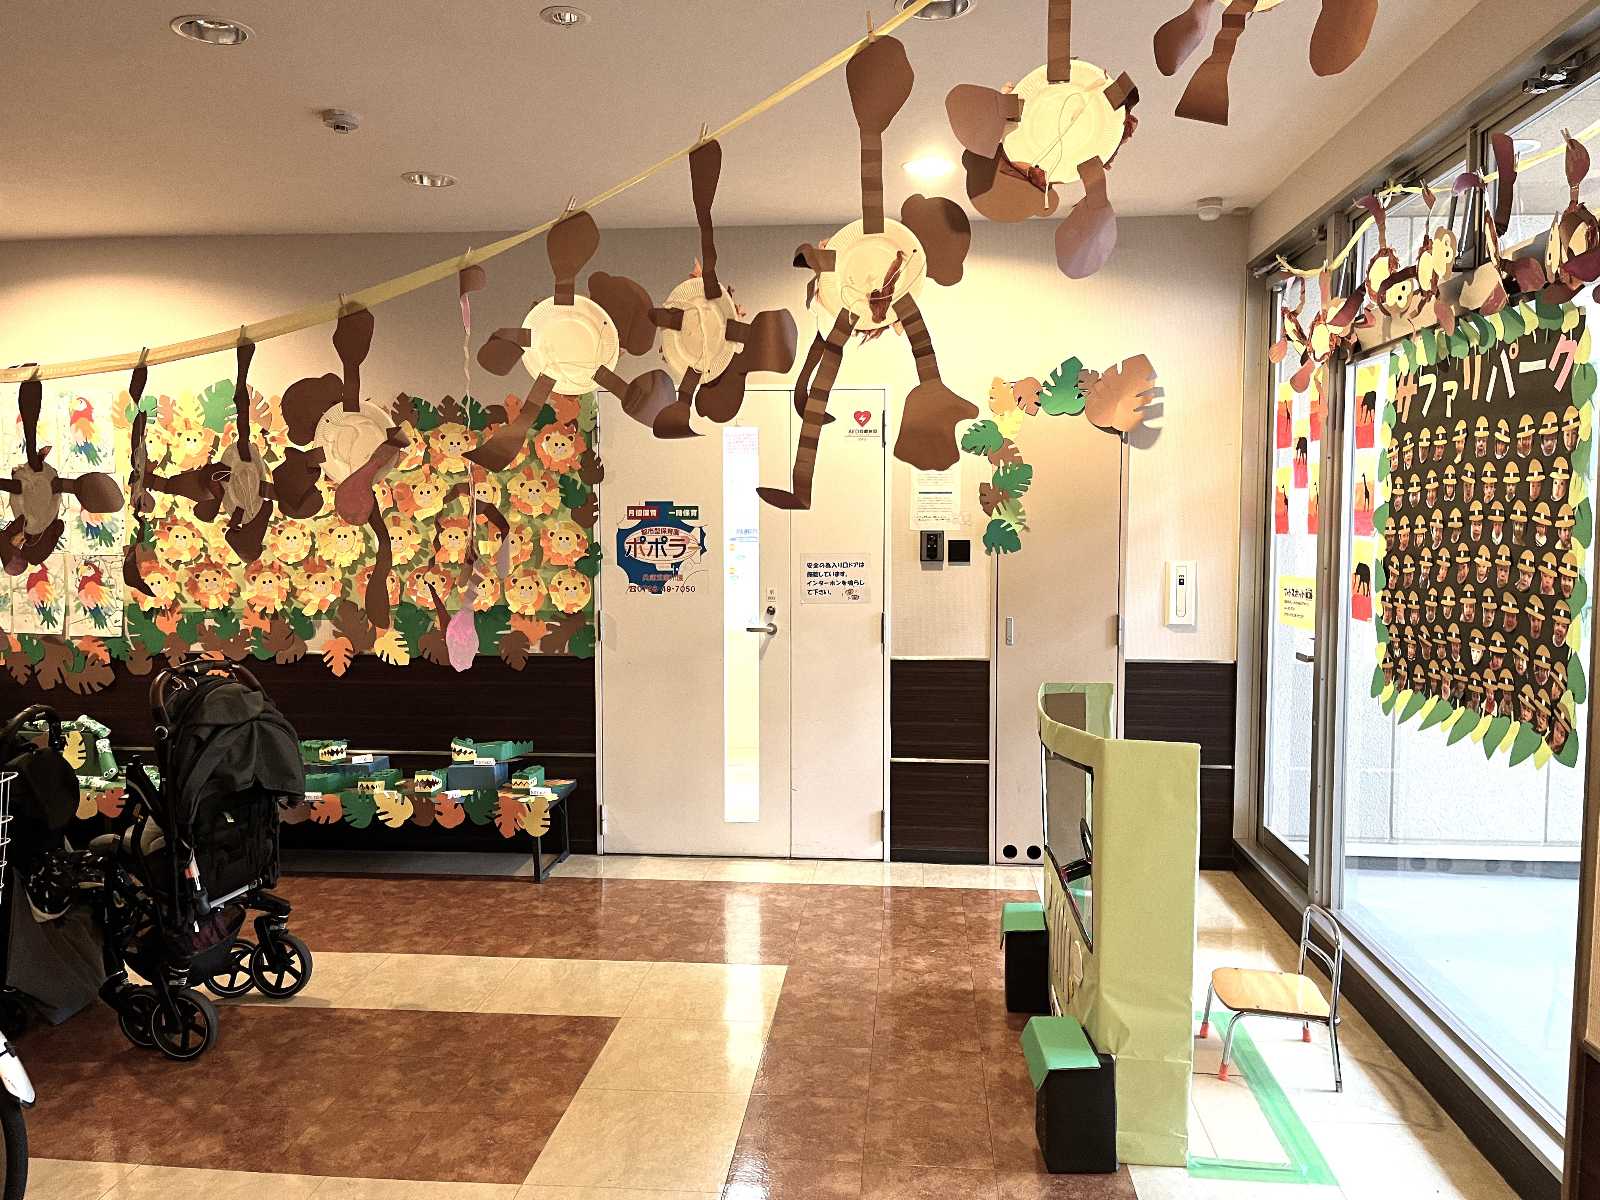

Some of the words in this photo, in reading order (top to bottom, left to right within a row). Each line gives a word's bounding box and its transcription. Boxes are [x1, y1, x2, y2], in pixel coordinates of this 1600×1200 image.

[1395, 334, 1578, 424] サファリパーク
